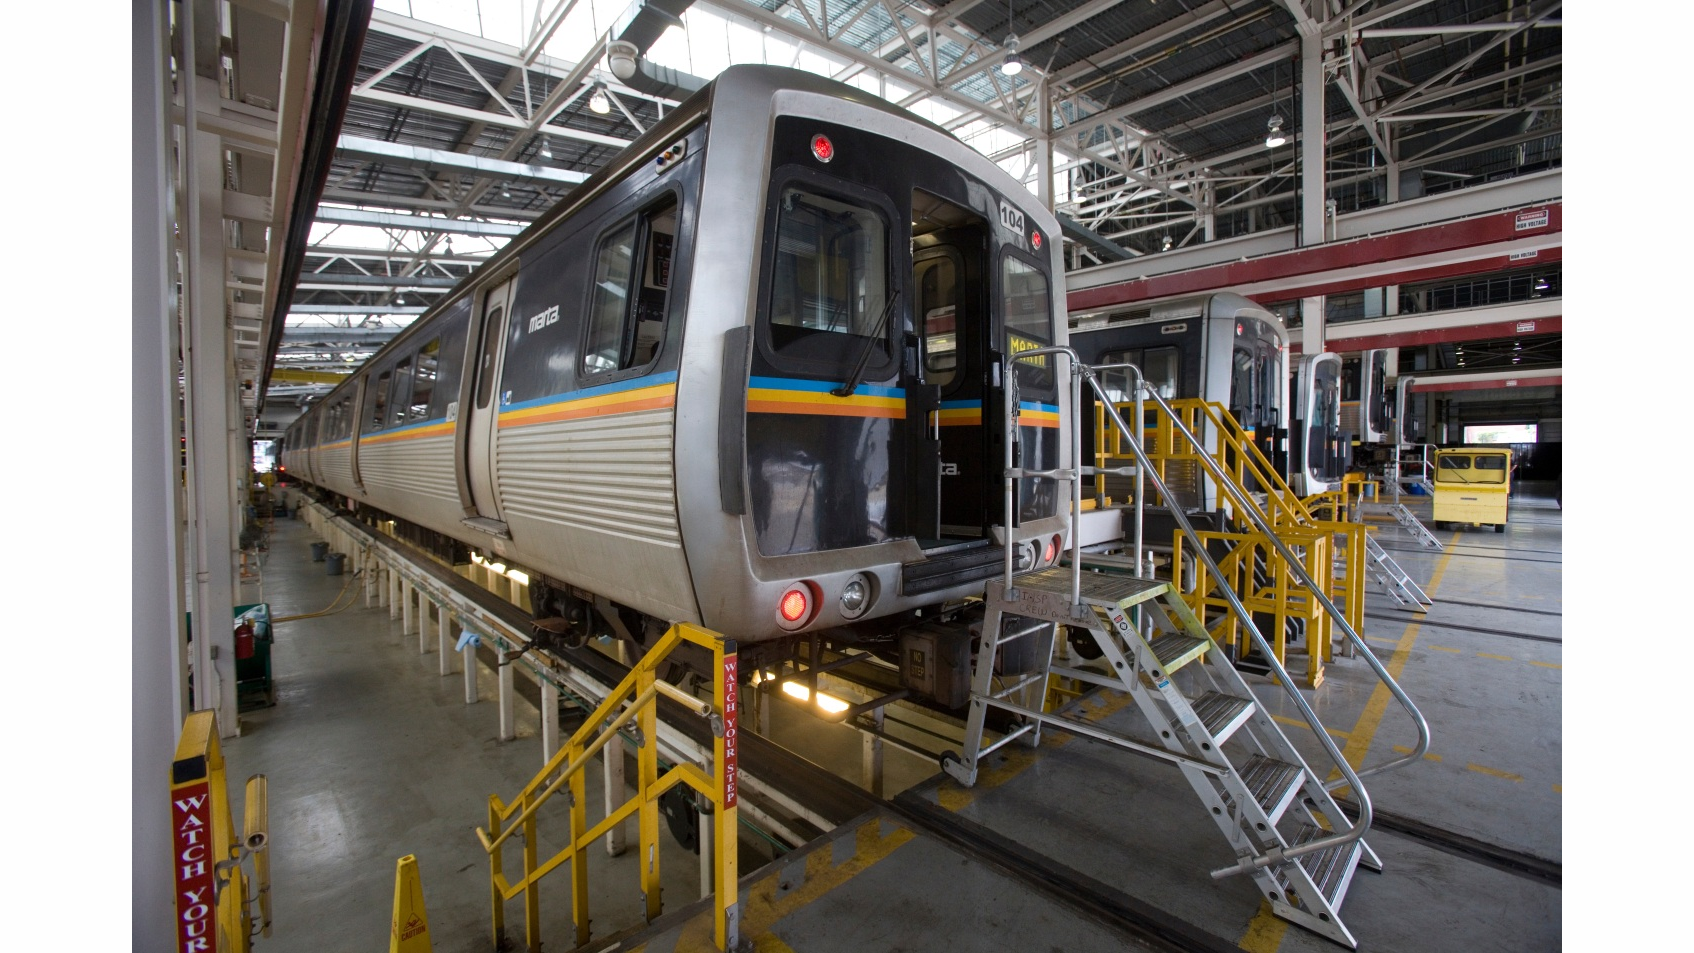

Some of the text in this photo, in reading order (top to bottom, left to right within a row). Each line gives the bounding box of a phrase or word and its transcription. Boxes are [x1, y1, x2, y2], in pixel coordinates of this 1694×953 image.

[1001, 206, 1024, 233] 104
[1528, 219, 1547, 227] VOLTAGE
[1520, 250, 1537, 258] VOLTAGE
[528, 305, 560, 334] marta
[913, 651, 922, 663] NO
[724, 662, 737, 803] WATCH YOUR STEP
[174, 793, 210, 953] WATCH YOUR
[401, 924, 426, 942] CAUTION
